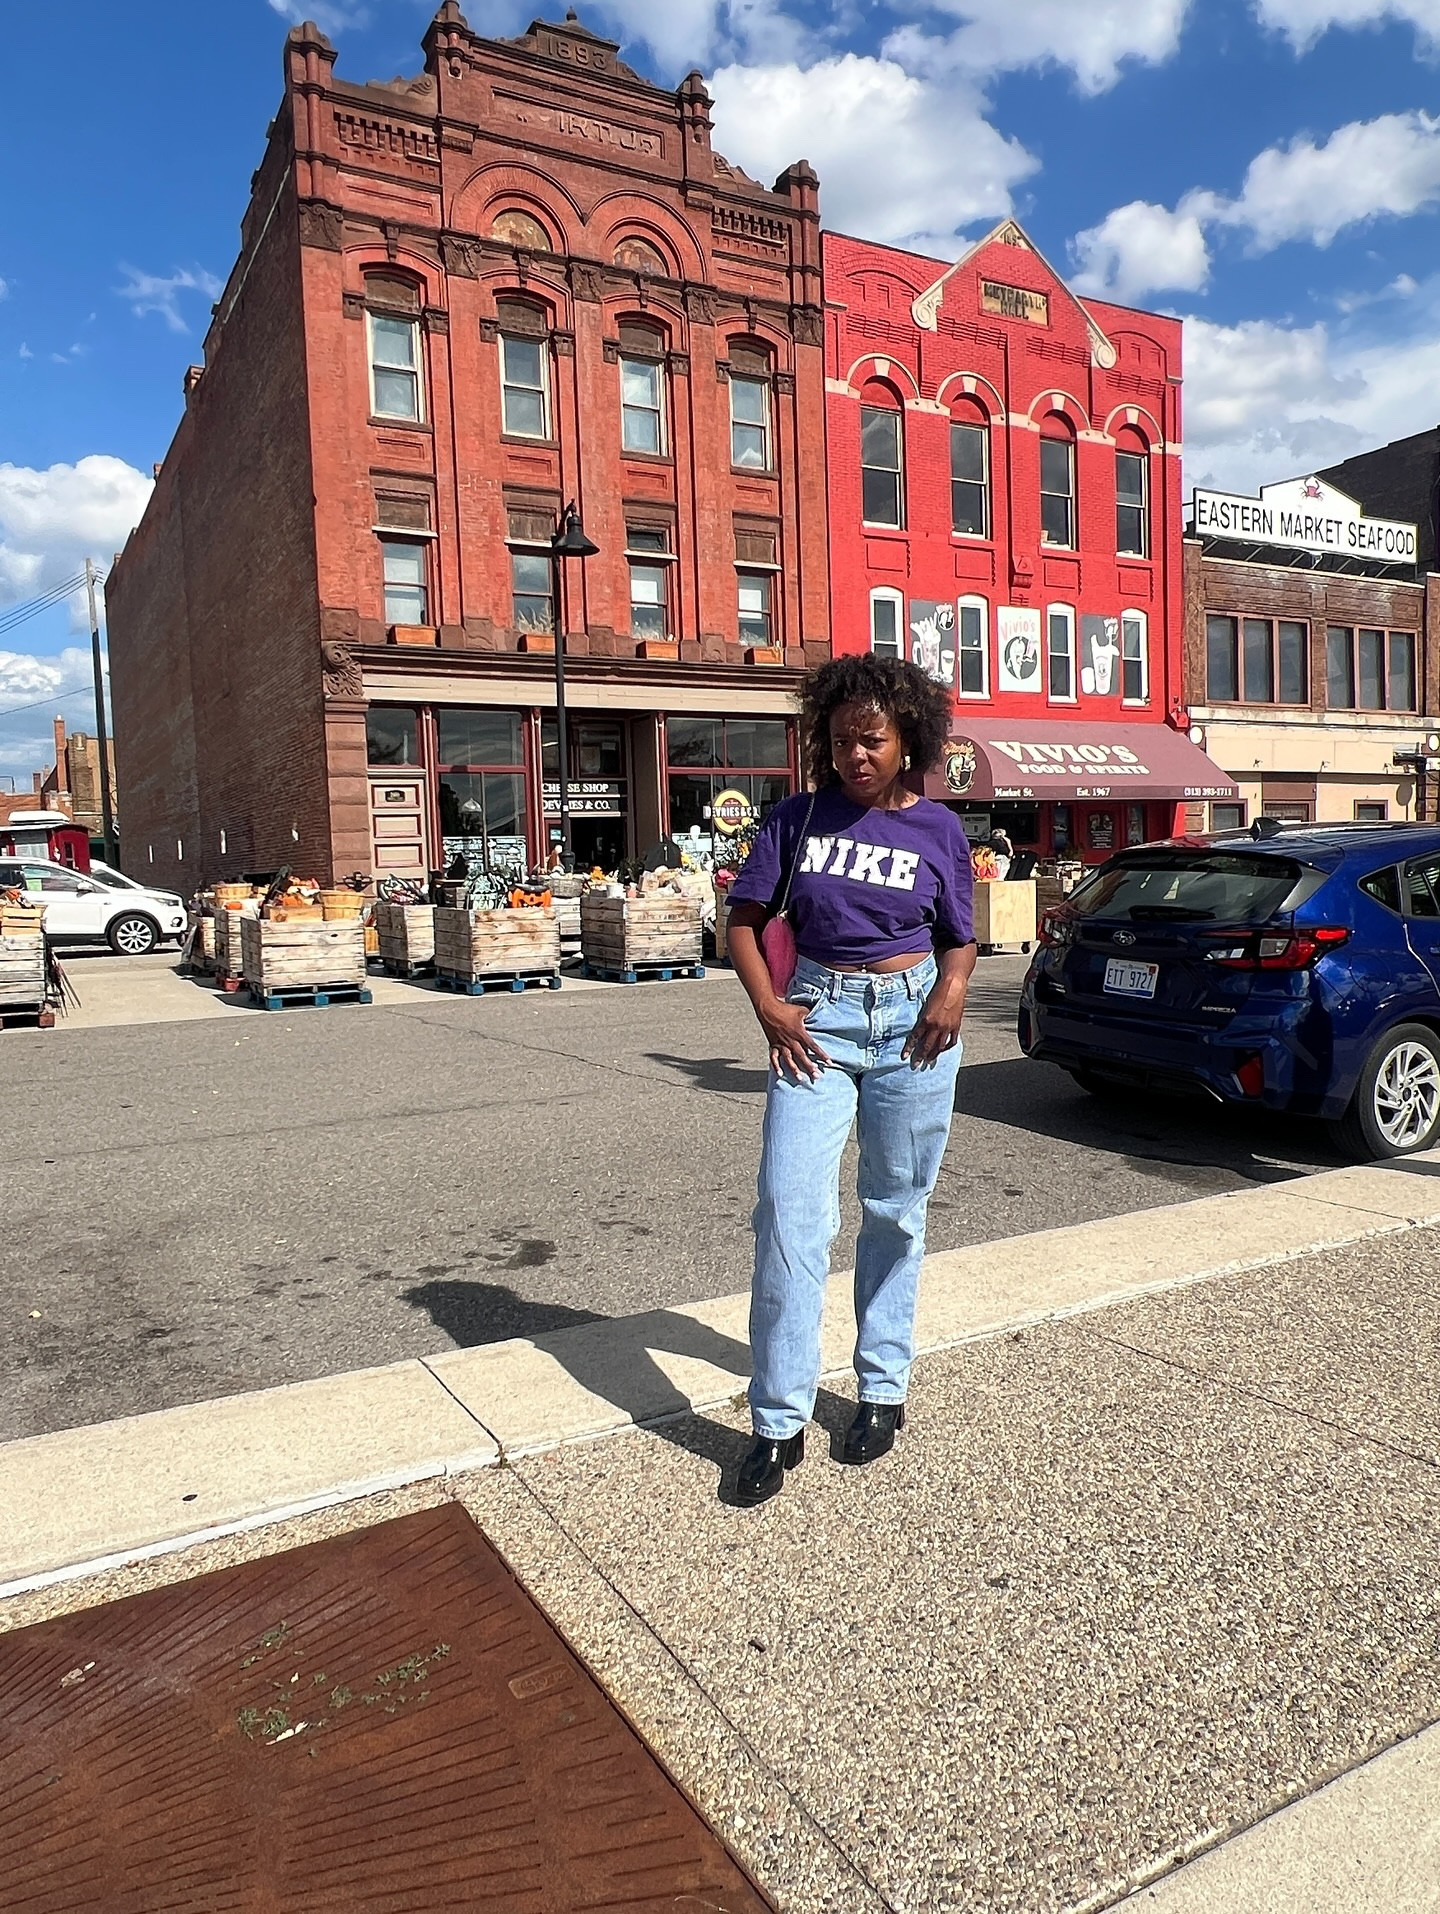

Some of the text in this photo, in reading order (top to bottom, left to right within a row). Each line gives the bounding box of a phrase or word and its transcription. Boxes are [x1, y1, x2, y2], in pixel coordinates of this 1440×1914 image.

[548, 36, 607, 70] 1893
[1198, 499, 1415, 555] EASTERN MARKET SEAFOOD
[988, 740, 1139, 763] VIVIO'S
[1016, 763, 1151, 775] FOOD & SPIRITS
[543, 783, 609, 793] CHESE SHOP
[994, 787, 1035, 797] Market St.
[1076, 787, 1111, 797] Est. 1967
[543, 800, 584, 810] DEVIES
[585, 800, 594, 810] &
[799, 836, 921, 891] NIKE
[1106, 968, 1153, 990] ETT 9727
